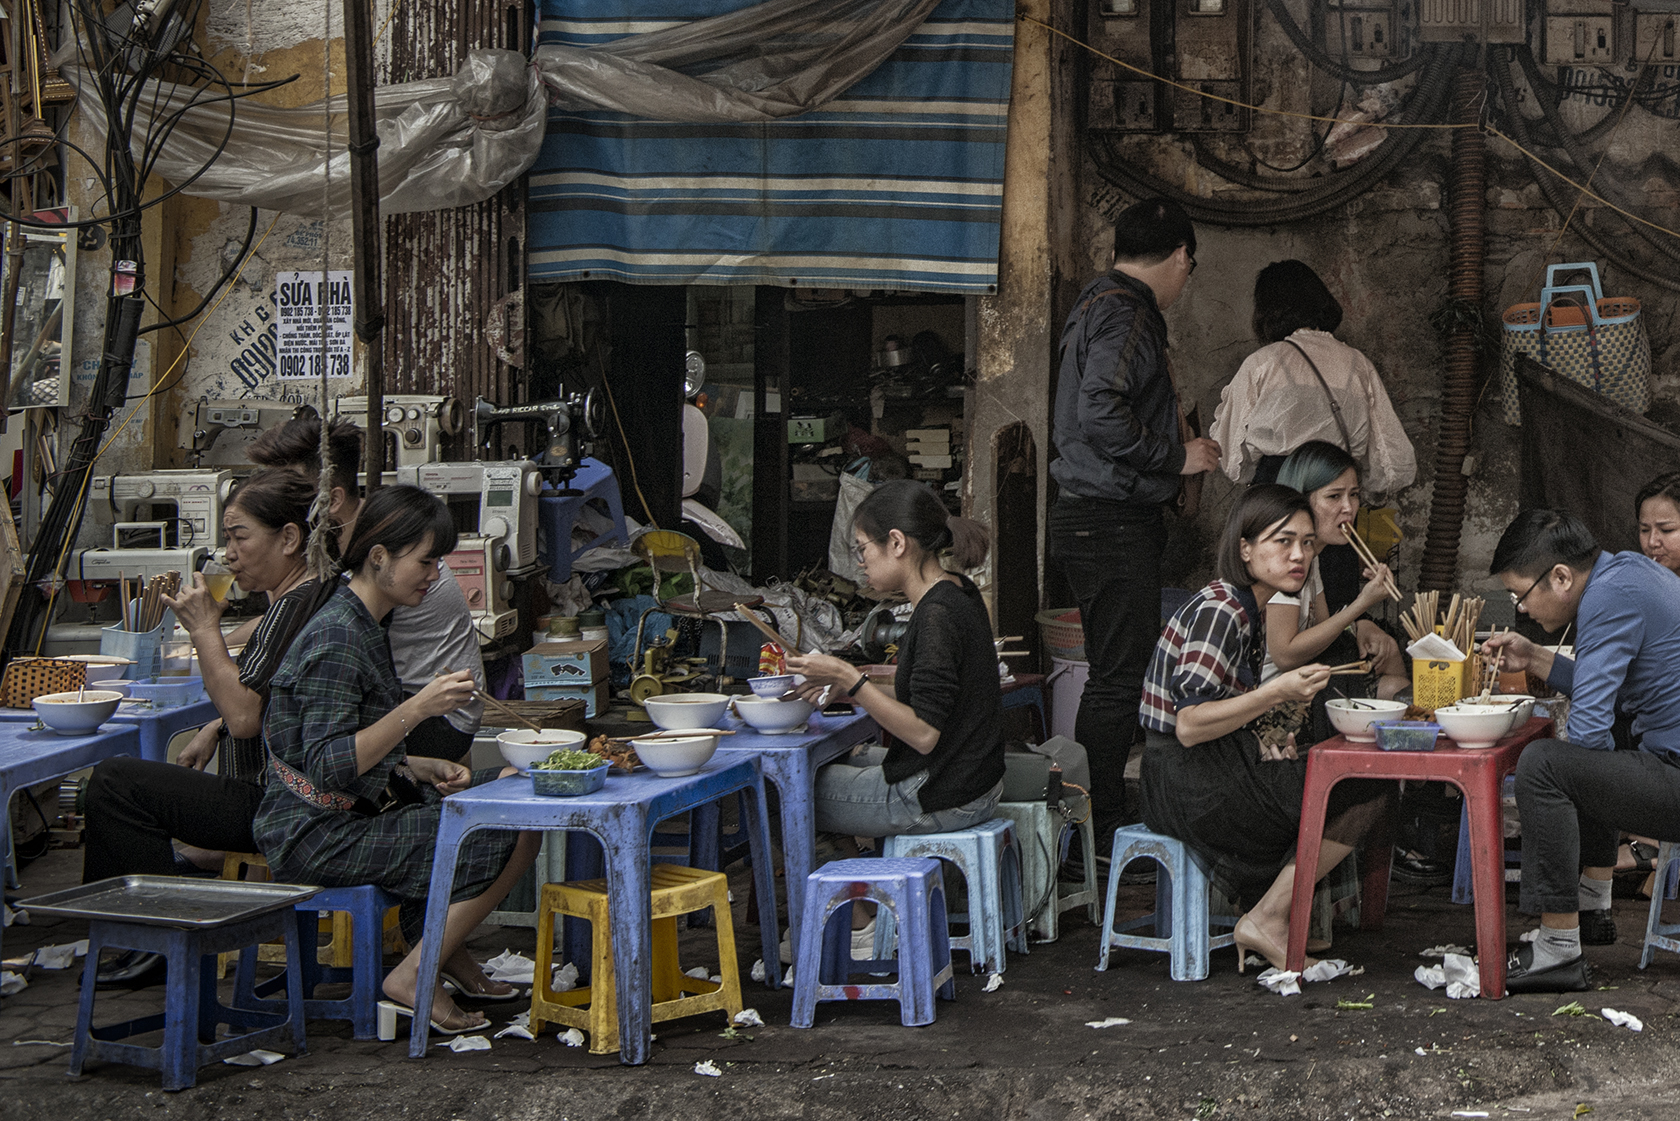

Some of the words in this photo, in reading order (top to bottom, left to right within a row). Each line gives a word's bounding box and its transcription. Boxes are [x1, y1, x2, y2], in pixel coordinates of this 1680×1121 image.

[280, 272, 313, 306] SỬA
[281, 306, 293, 317] 0902
[304, 306, 313, 316] 738
[280, 355, 306, 377] 0902
[309, 355, 327, 376] 18
[330, 354, 350, 376] 738
